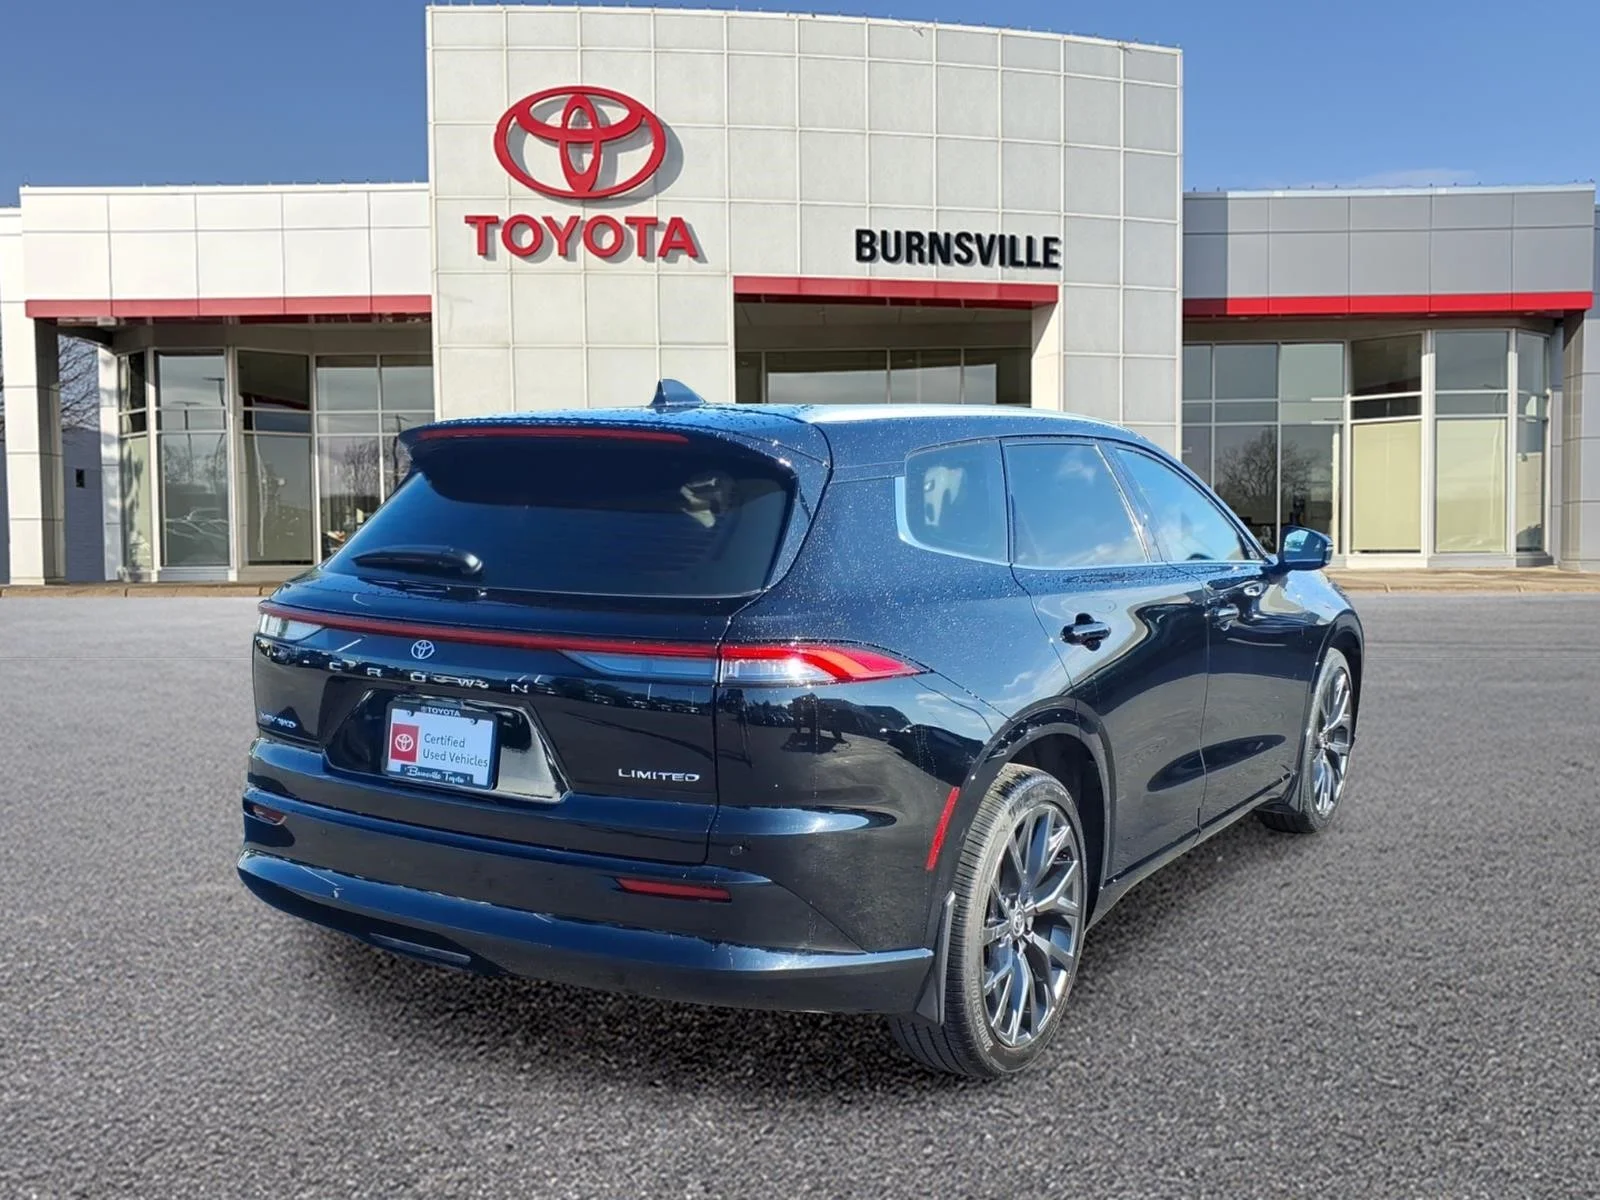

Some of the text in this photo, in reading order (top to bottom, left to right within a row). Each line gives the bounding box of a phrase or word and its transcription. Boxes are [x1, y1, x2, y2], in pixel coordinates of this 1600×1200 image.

[464, 214, 699, 258] TOYOTA
[855, 228, 1061, 269] BURNSVILLE
[329, 660, 529, 694] CROWN
[427, 707, 461, 717] TOYOTA
[424, 733, 465, 748] Certified
[423, 749, 488, 768] Used Vehicles
[618, 768, 700, 782] LIMITED
